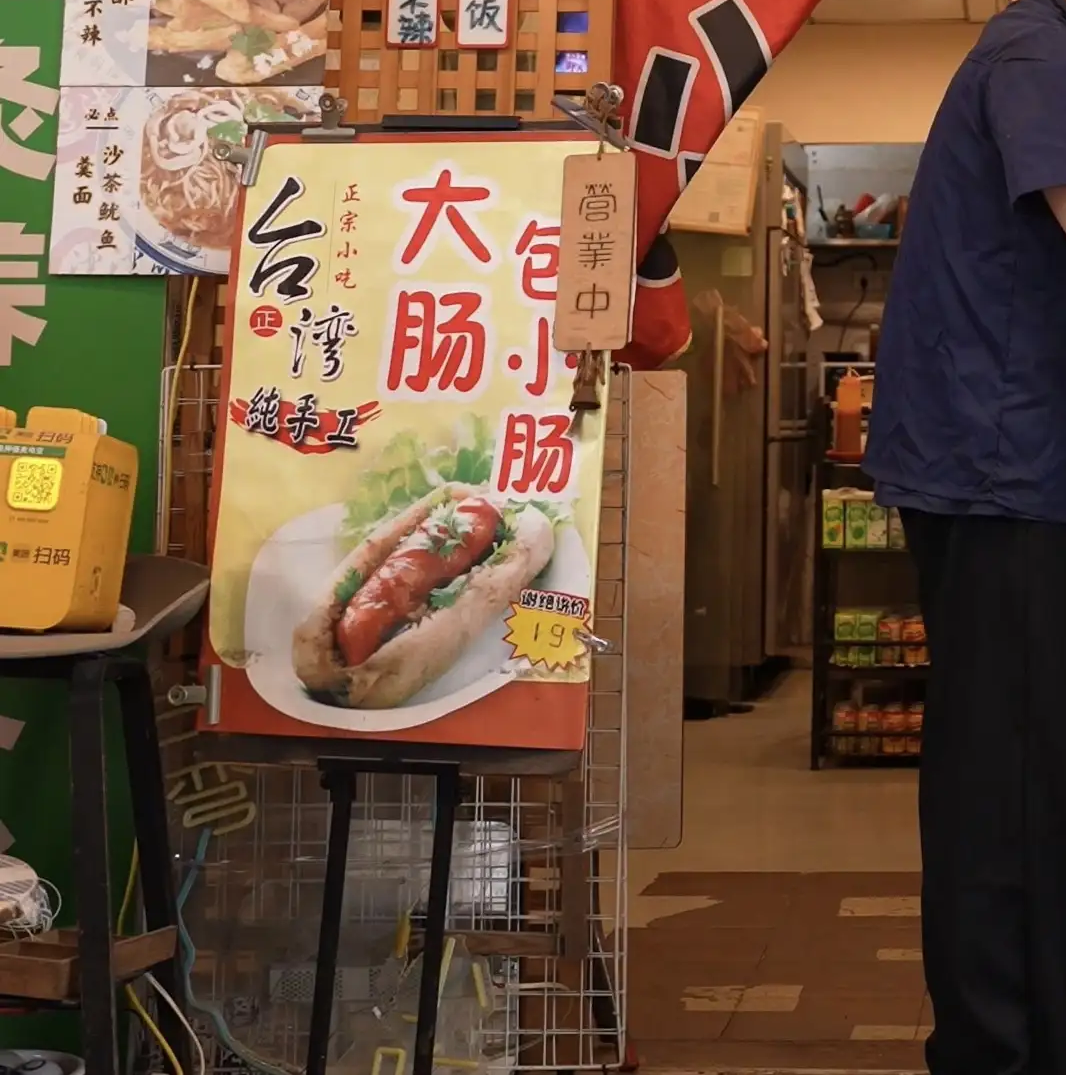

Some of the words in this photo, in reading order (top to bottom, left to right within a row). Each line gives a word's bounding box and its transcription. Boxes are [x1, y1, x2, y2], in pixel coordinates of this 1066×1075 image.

[84, 106, 120, 122] 必点
[97, 145, 125, 250] 沙茶鱿鱼
[334, 183, 362, 291] 正宗小吃
[387, 169, 492, 393] 大肠
[33, 546, 71, 566] 扫码
[533, 622, 566, 648] 19
